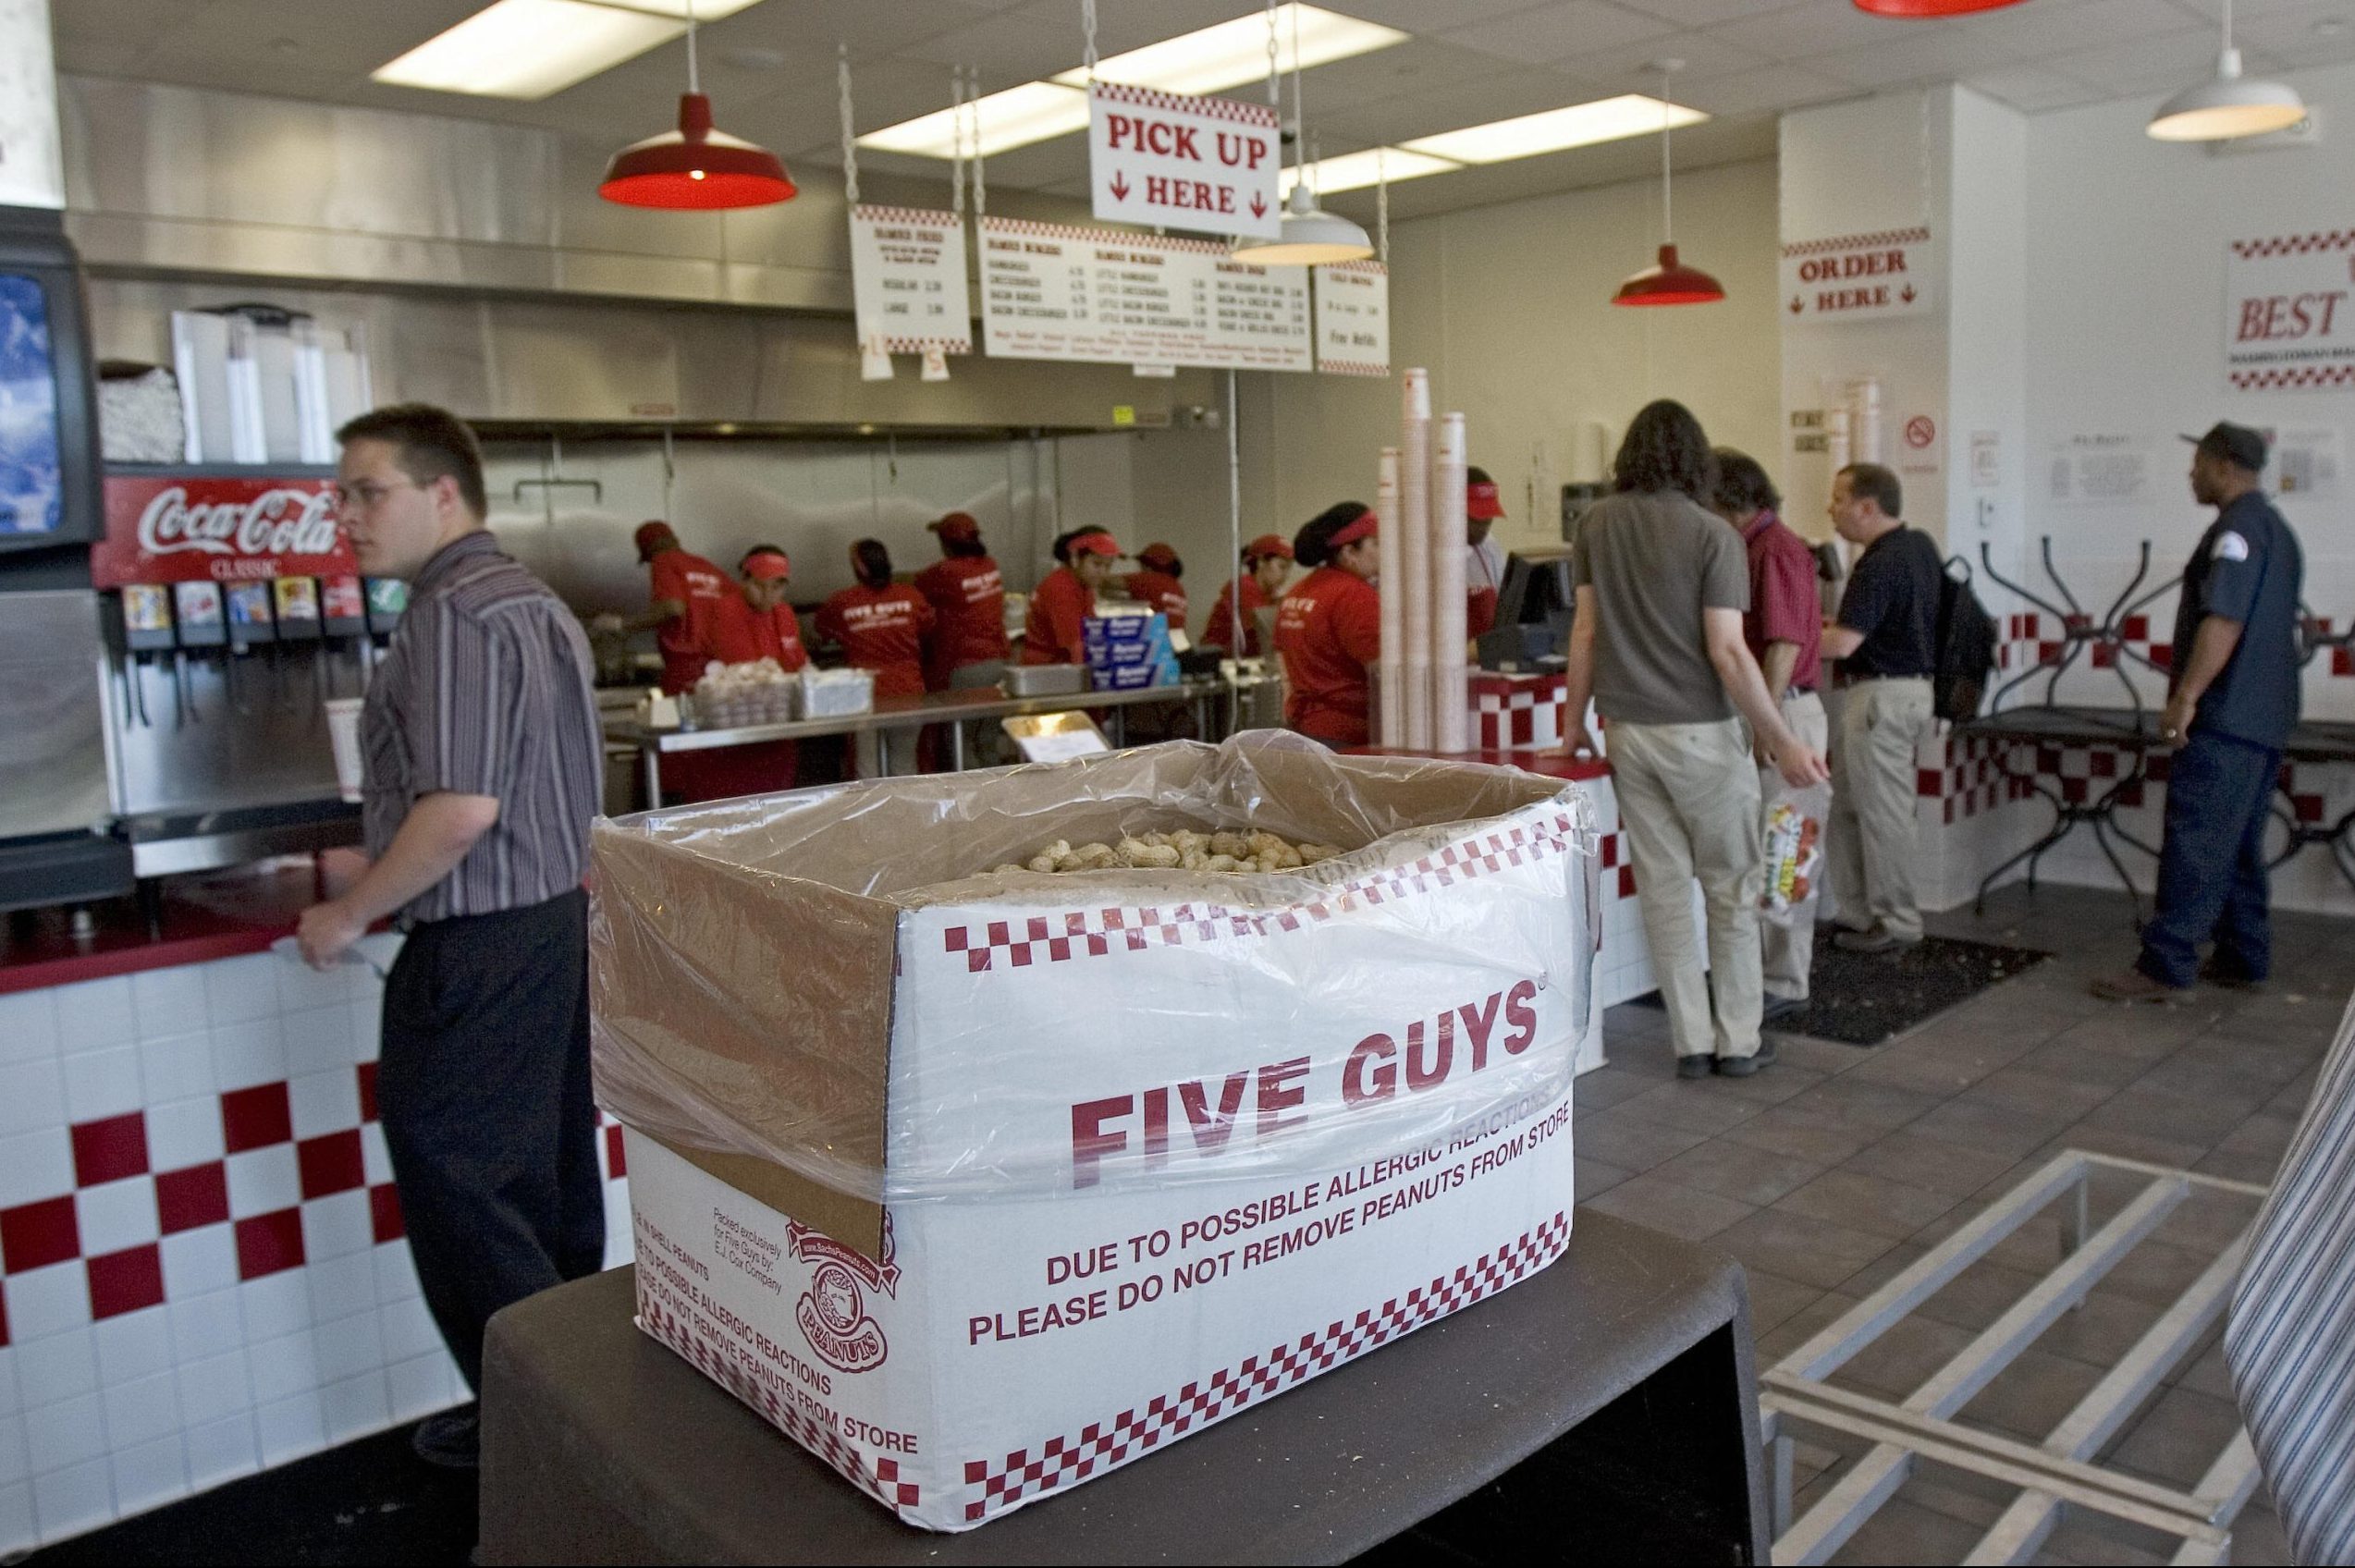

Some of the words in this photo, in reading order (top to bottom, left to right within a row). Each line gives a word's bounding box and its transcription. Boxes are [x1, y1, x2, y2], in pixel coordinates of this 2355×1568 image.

[1107, 112, 1201, 162] PICK
[1216, 132, 1268, 170] UP
[1146, 175, 1236, 214] HERE
[1799, 250, 1907, 282] ORDER
[1817, 285, 1891, 312] HERE
[2235, 290, 2349, 343] BEST
[139, 486, 337, 555] Coca-Cola
[209, 557, 279, 579] CLASSIC
[1071, 1056, 1312, 1190] FIVE
[1342, 978, 1539, 1110] GUYS
[713, 1207, 740, 1233] Packed
[740, 1227, 782, 1260] exclusively
[969, 1290, 1108, 1346] PLEASE
[1118, 1274, 1164, 1311] DO
[1172, 1250, 1236, 1292] NOT
[1243, 1207, 1355, 1270] REMOVE
[1362, 1163, 1466, 1225] PEANUTS
[1470, 1133, 1525, 1181] FROM
[1527, 1099, 1569, 1149] STORE
[1047, 1243, 1119, 1286] DUE
[1128, 1230, 1171, 1263] TO
[1180, 1182, 1320, 1249] POSSIBLE
[1326, 1138, 1442, 1202] ALLERGIC
[673, 1243, 709, 1282] PEANUTS
[725, 1231, 740, 1250] Five
[741, 1241, 760, 1264] Guys
[729, 1250, 743, 1269] Cox
[745, 1260, 782, 1295] Company
[656, 1255, 699, 1305] POSSIBLE
[701, 1292, 753, 1344] ALLERGIC
[756, 1332, 832, 1396] REACTIONS
[802, 1305, 879, 1363] PEANUTS
[657, 1282, 672, 1306] DO
[672, 1295, 692, 1321] NOT
[693, 1313, 738, 1361] REMOVE
[740, 1347, 795, 1402] PEANUTS
[798, 1390, 840, 1432] FROM
[843, 1416, 918, 1454] STORE
